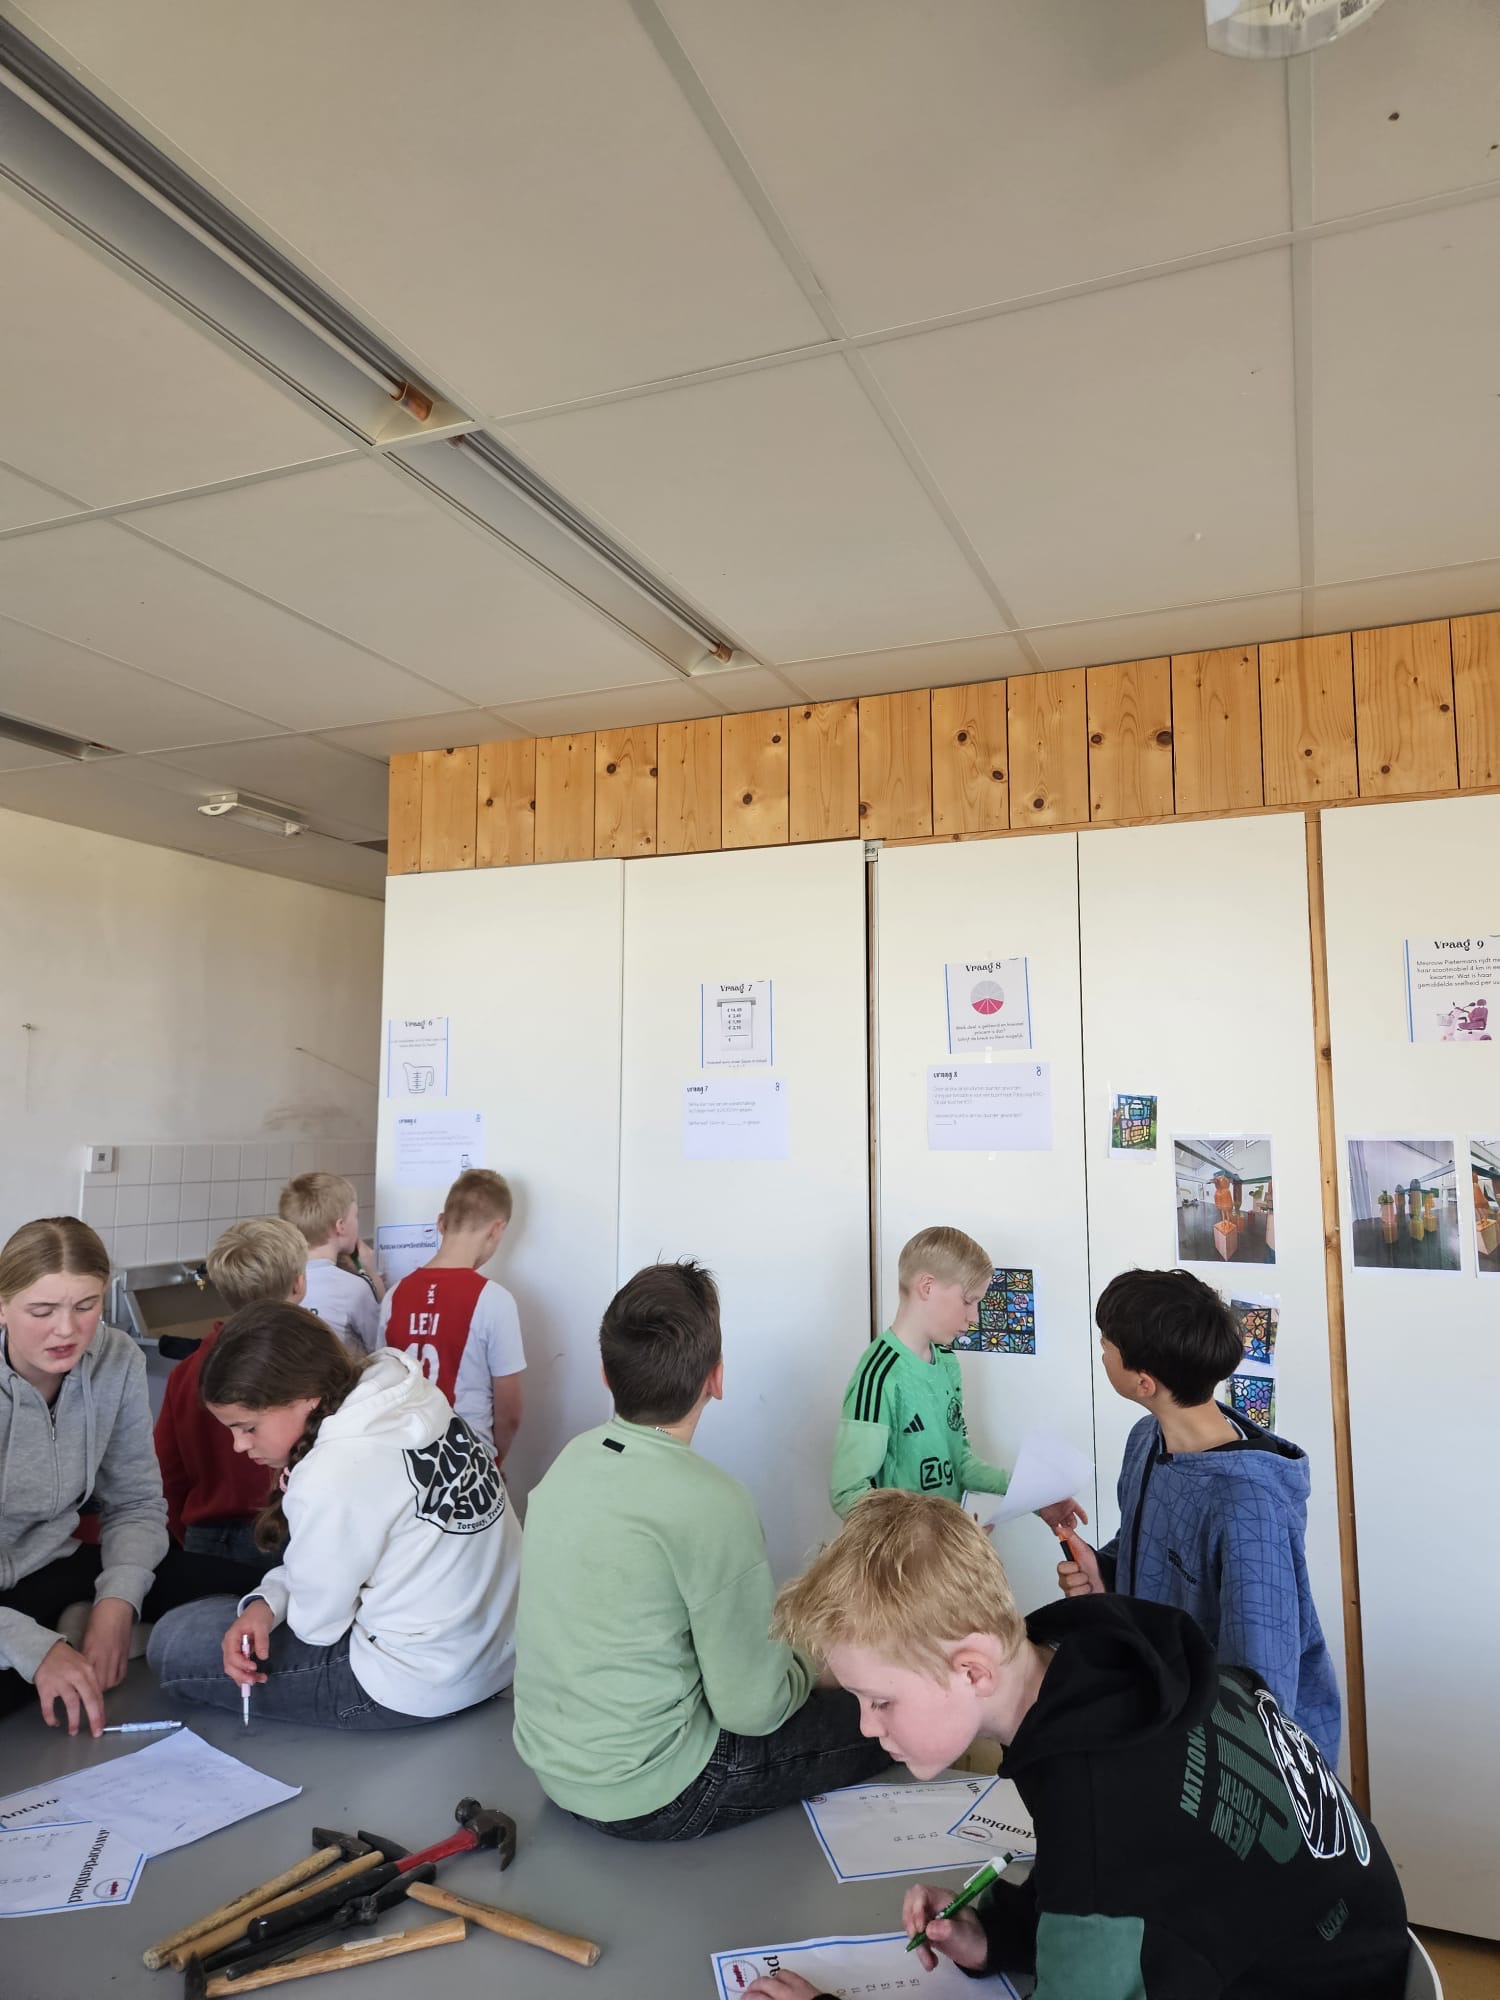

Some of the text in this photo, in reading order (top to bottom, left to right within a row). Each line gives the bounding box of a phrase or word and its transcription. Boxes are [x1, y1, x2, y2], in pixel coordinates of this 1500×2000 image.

[1434, 939, 1484, 951] Vraag 9
[965, 962, 993, 973] Vraag
[720, 984, 744, 994] Vraag
[1179, 1722, 1206, 1819] NATIONA
